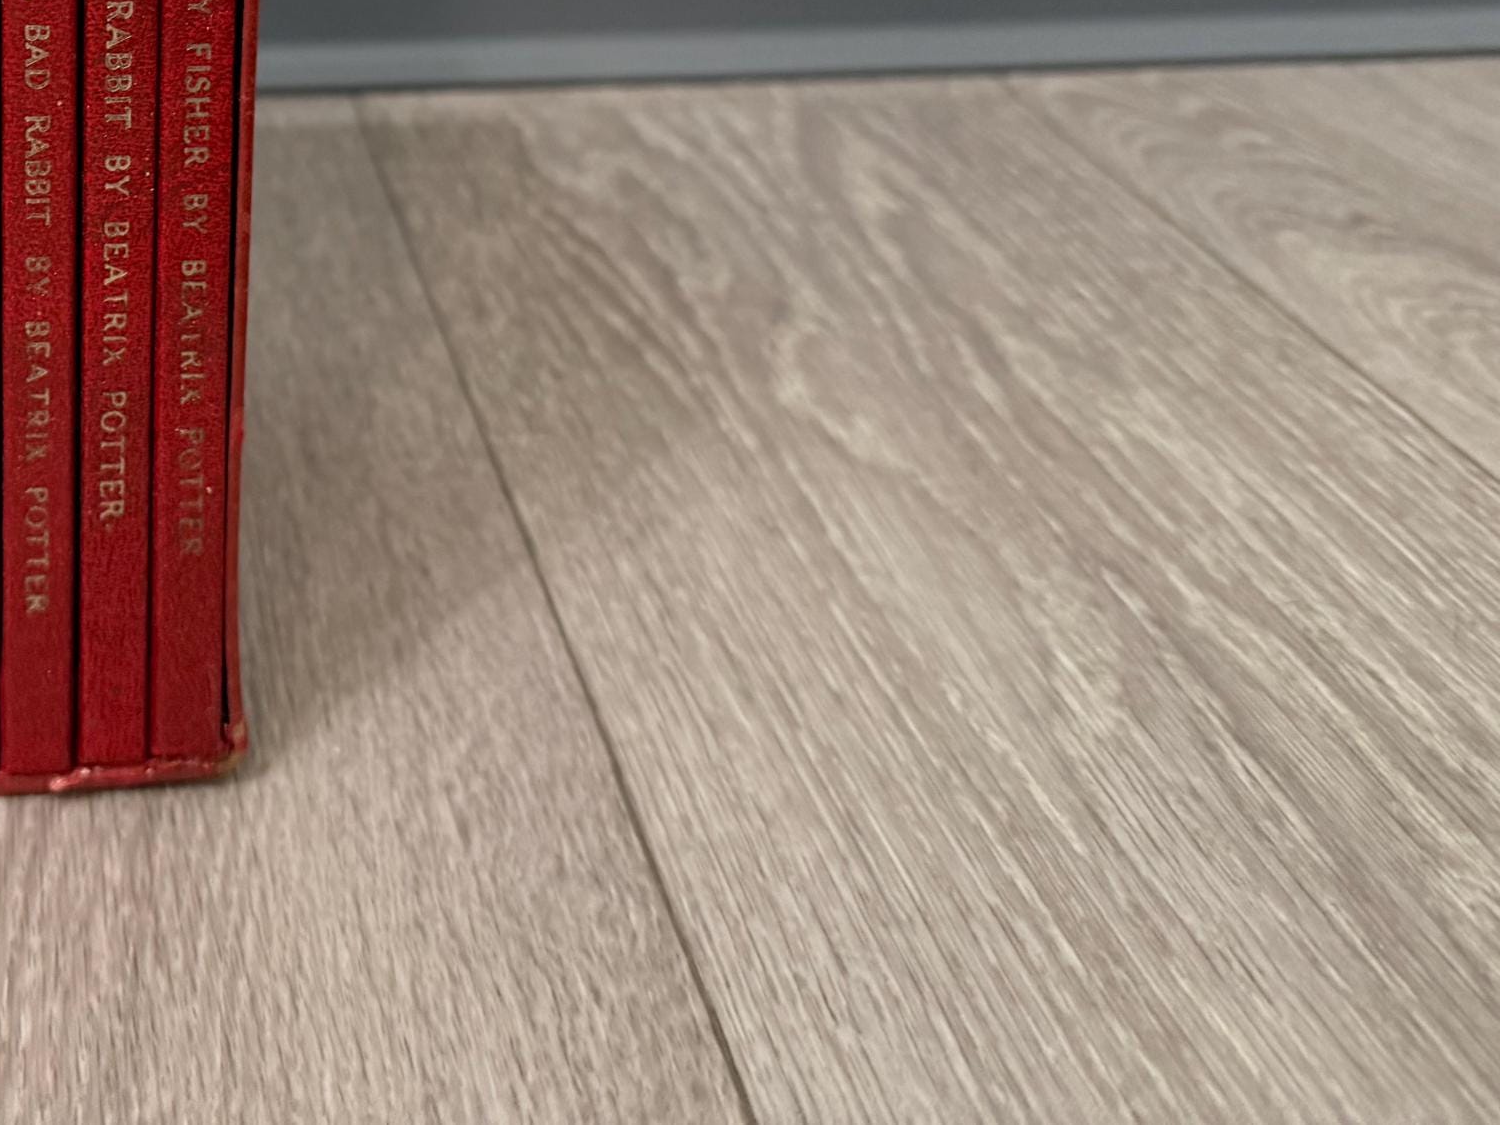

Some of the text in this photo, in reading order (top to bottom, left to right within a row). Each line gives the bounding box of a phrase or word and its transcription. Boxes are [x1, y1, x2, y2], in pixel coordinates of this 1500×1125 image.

[24, 24, 50, 90] BAD
[104, 0, 134, 131] RABBIT
[183, 43, 212, 167] FISHER
[24, 115, 51, 227] RABBIT
[104, 154, 131, 196] BY
[182, 193, 209, 235] BY
[25, 255, 51, 296] BY
[103, 221, 130, 366] BEATRIX
[180, 259, 206, 405] BEATRIX
[25, 320, 50, 462] BEATRIX
[99, 390, 127, 521] POTTER
[25, 486, 49, 616] POTTER
